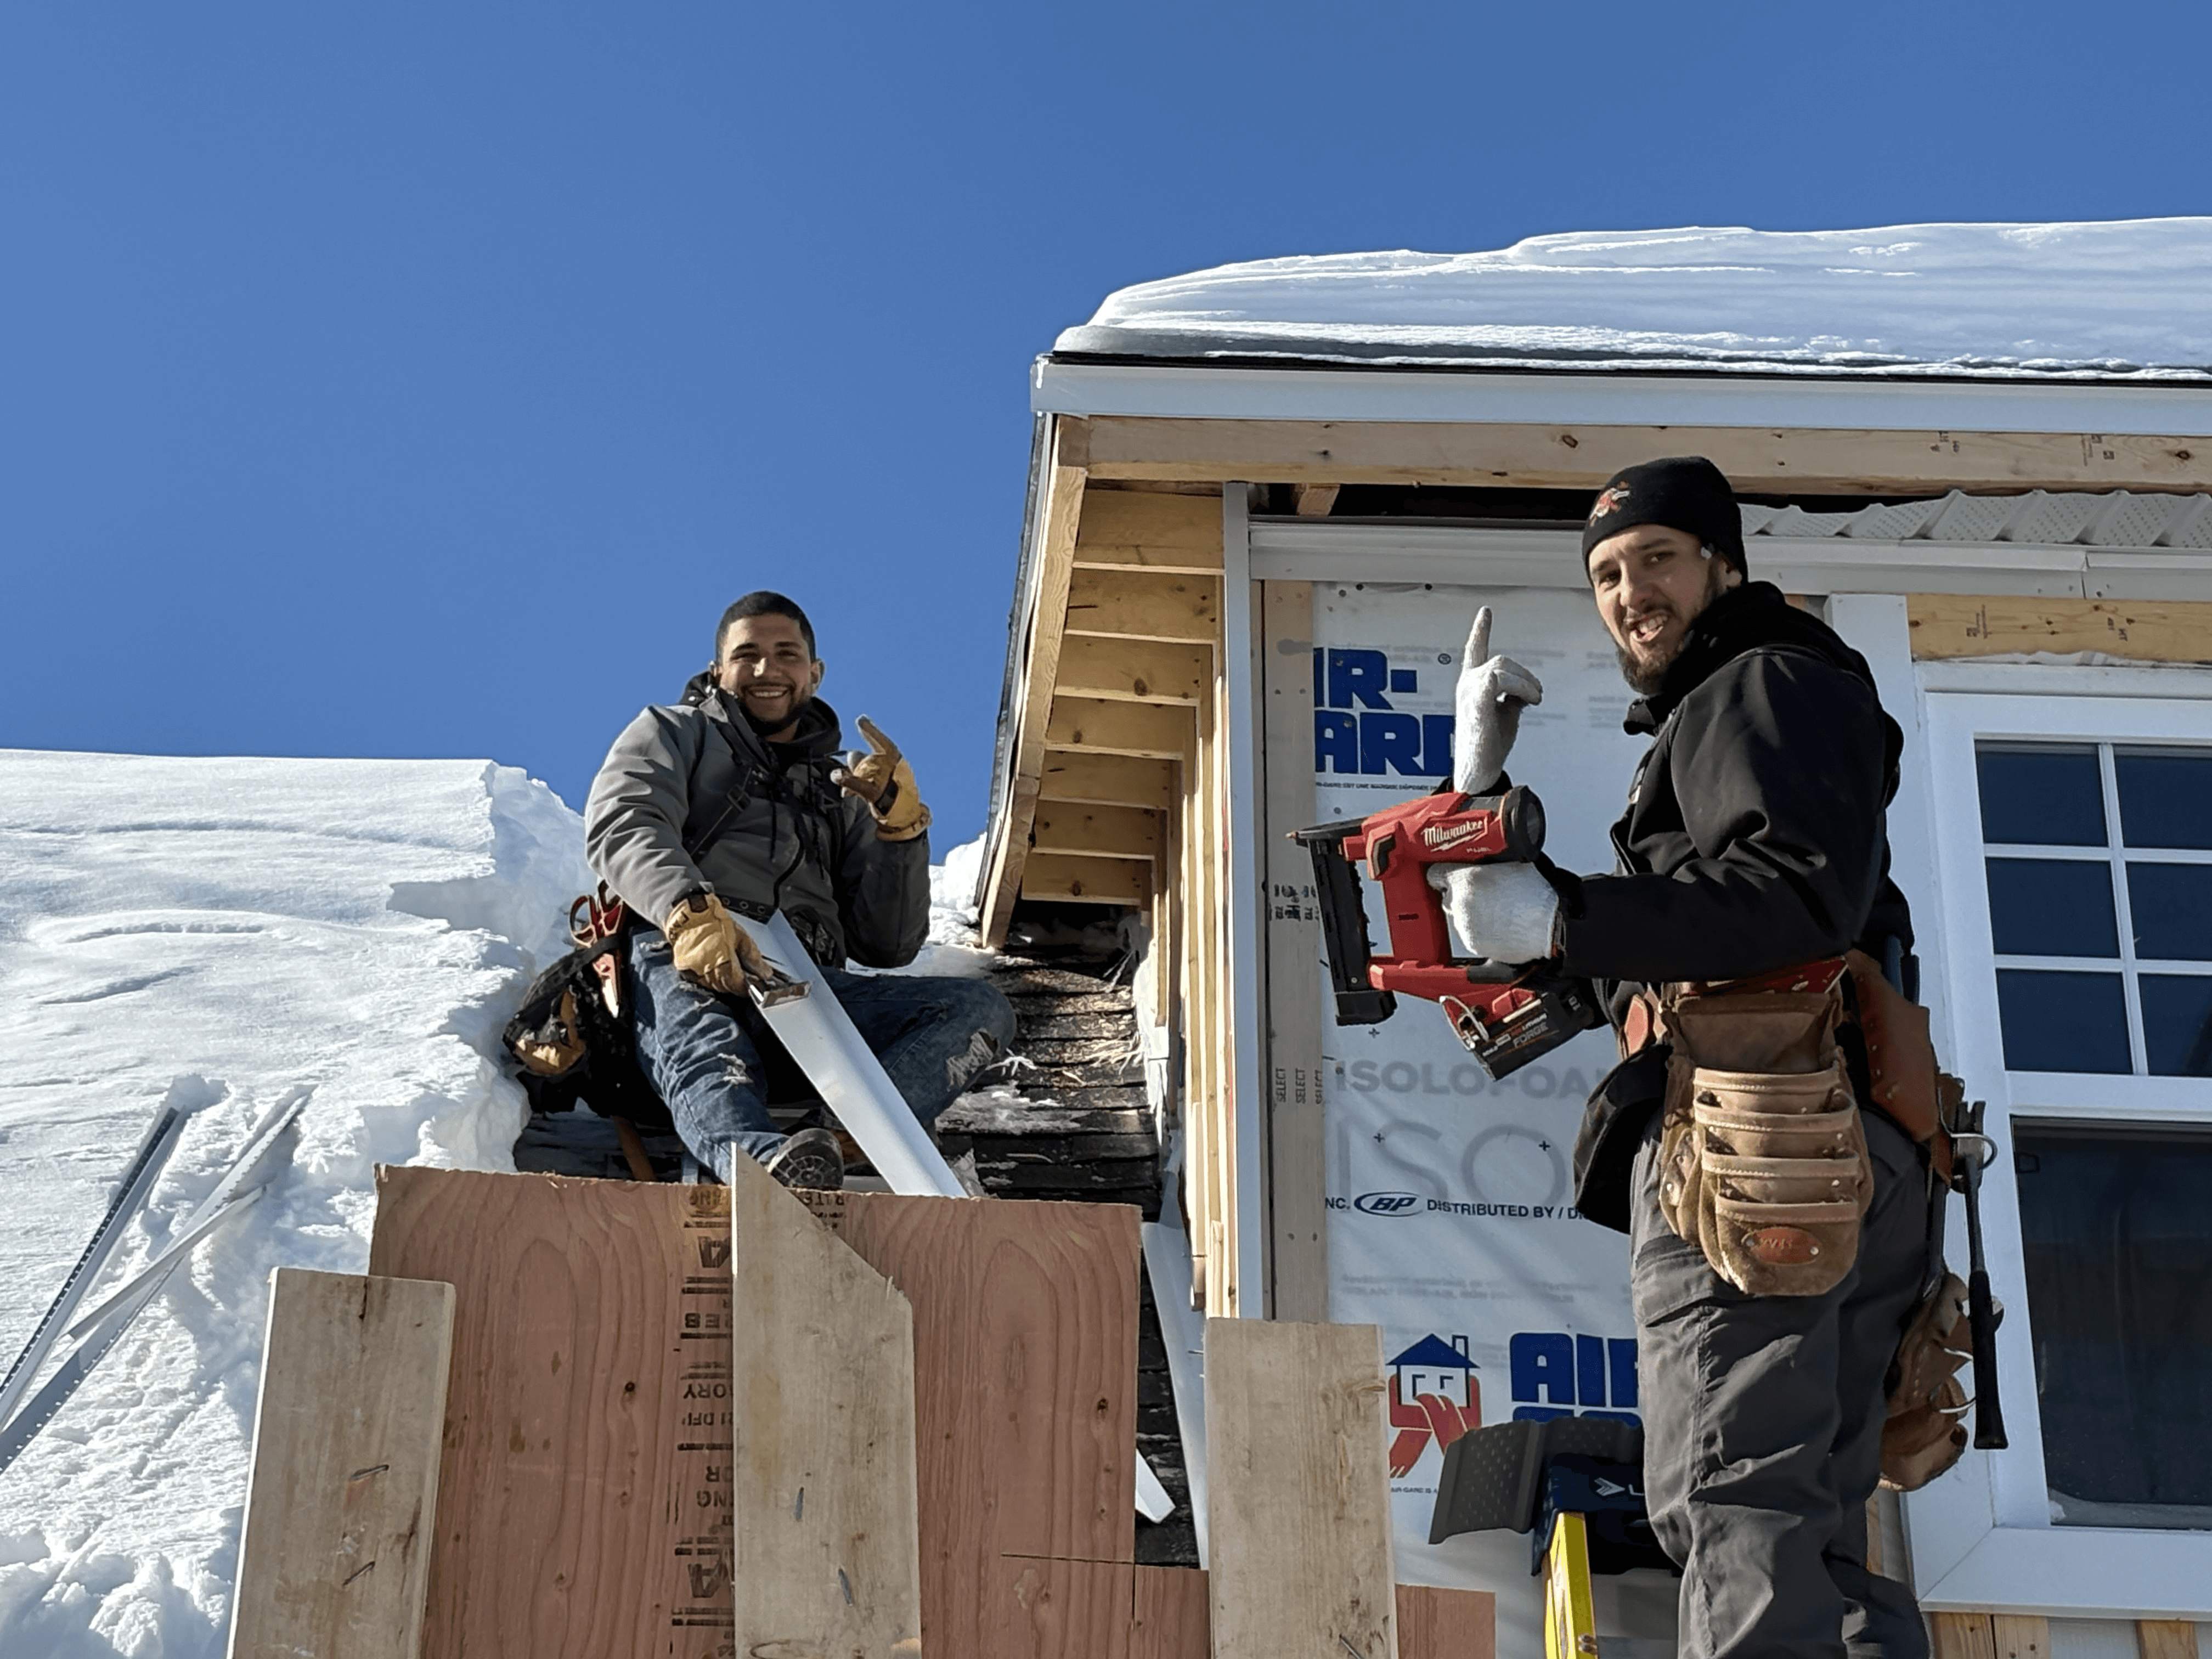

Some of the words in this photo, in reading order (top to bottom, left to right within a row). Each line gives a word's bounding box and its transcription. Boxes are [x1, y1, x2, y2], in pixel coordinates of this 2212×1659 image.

[1420, 821, 1483, 846] Milwaukee
[1513, 1022, 1549, 1048] FORGE
[1276, 1067, 1286, 1103] SELECT
[1295, 1068, 1306, 1104] SELECT
[1427, 1199, 1528, 1217] DISTRIBUTED
[1533, 1206, 1554, 1218] BY
[682, 1383, 733, 1399] ORY
